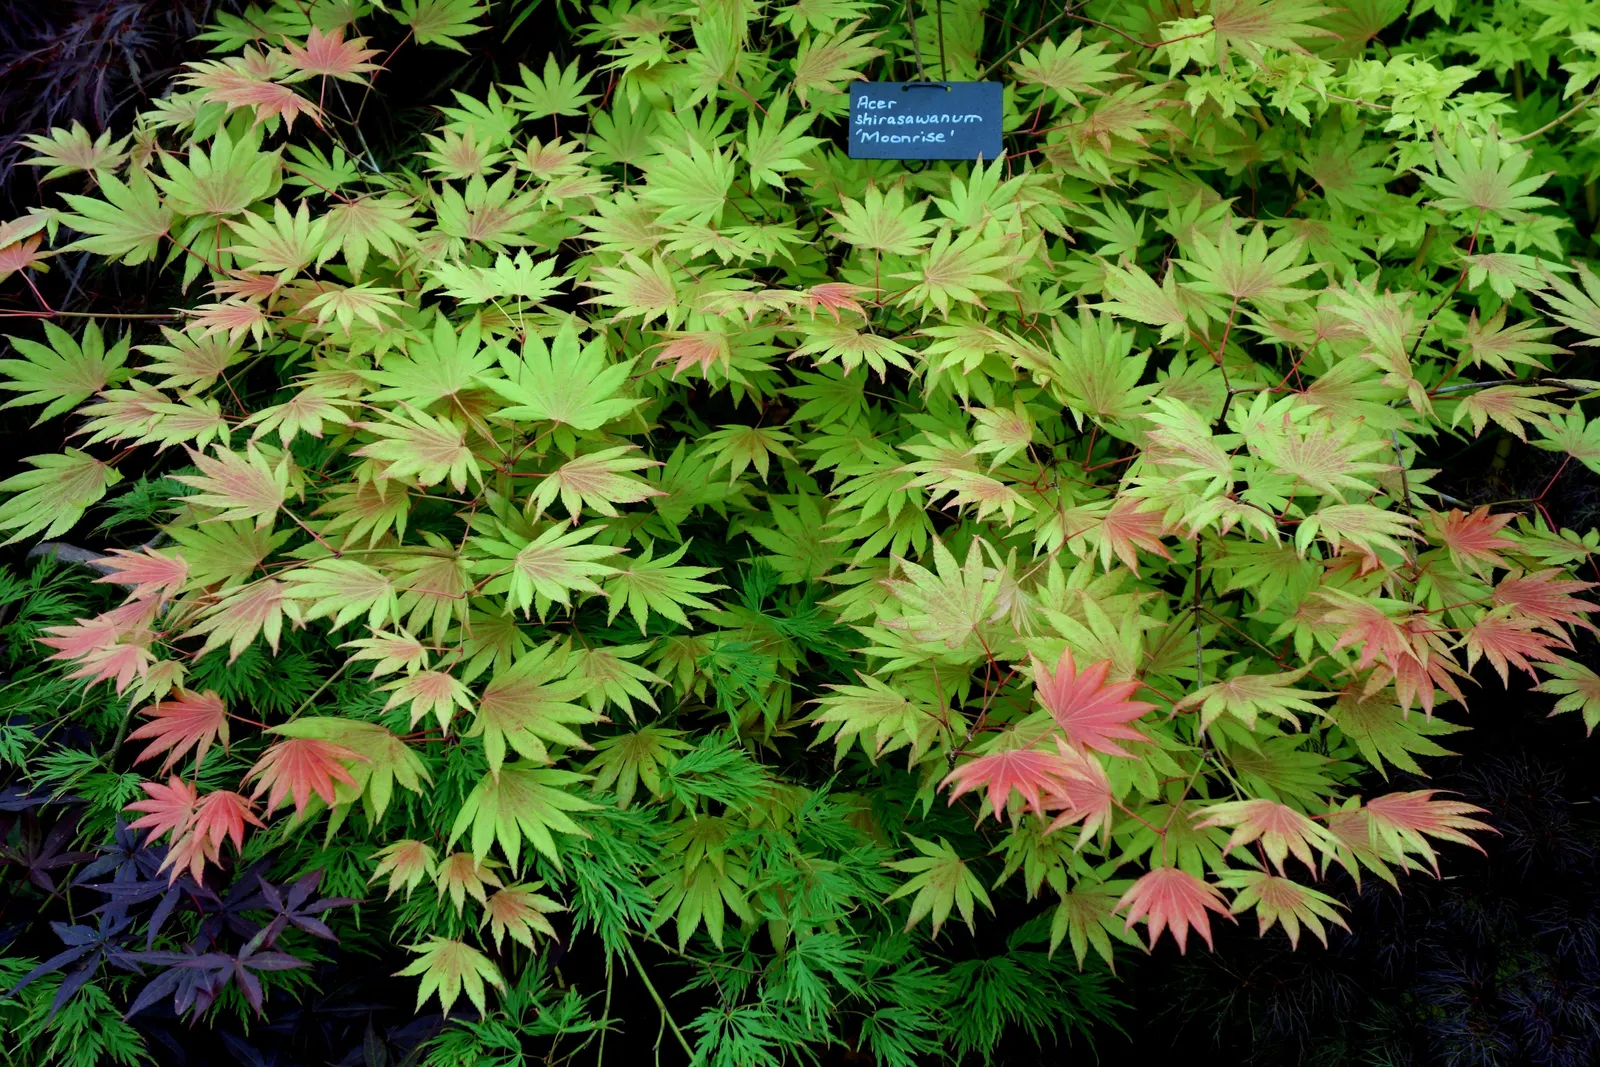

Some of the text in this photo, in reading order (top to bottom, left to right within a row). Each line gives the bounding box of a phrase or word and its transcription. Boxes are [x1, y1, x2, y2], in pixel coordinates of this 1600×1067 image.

[856, 95, 897, 110] Acer
[855, 112, 983, 126] shirasawanum
[855, 128, 955, 144] 'Moonrise'
